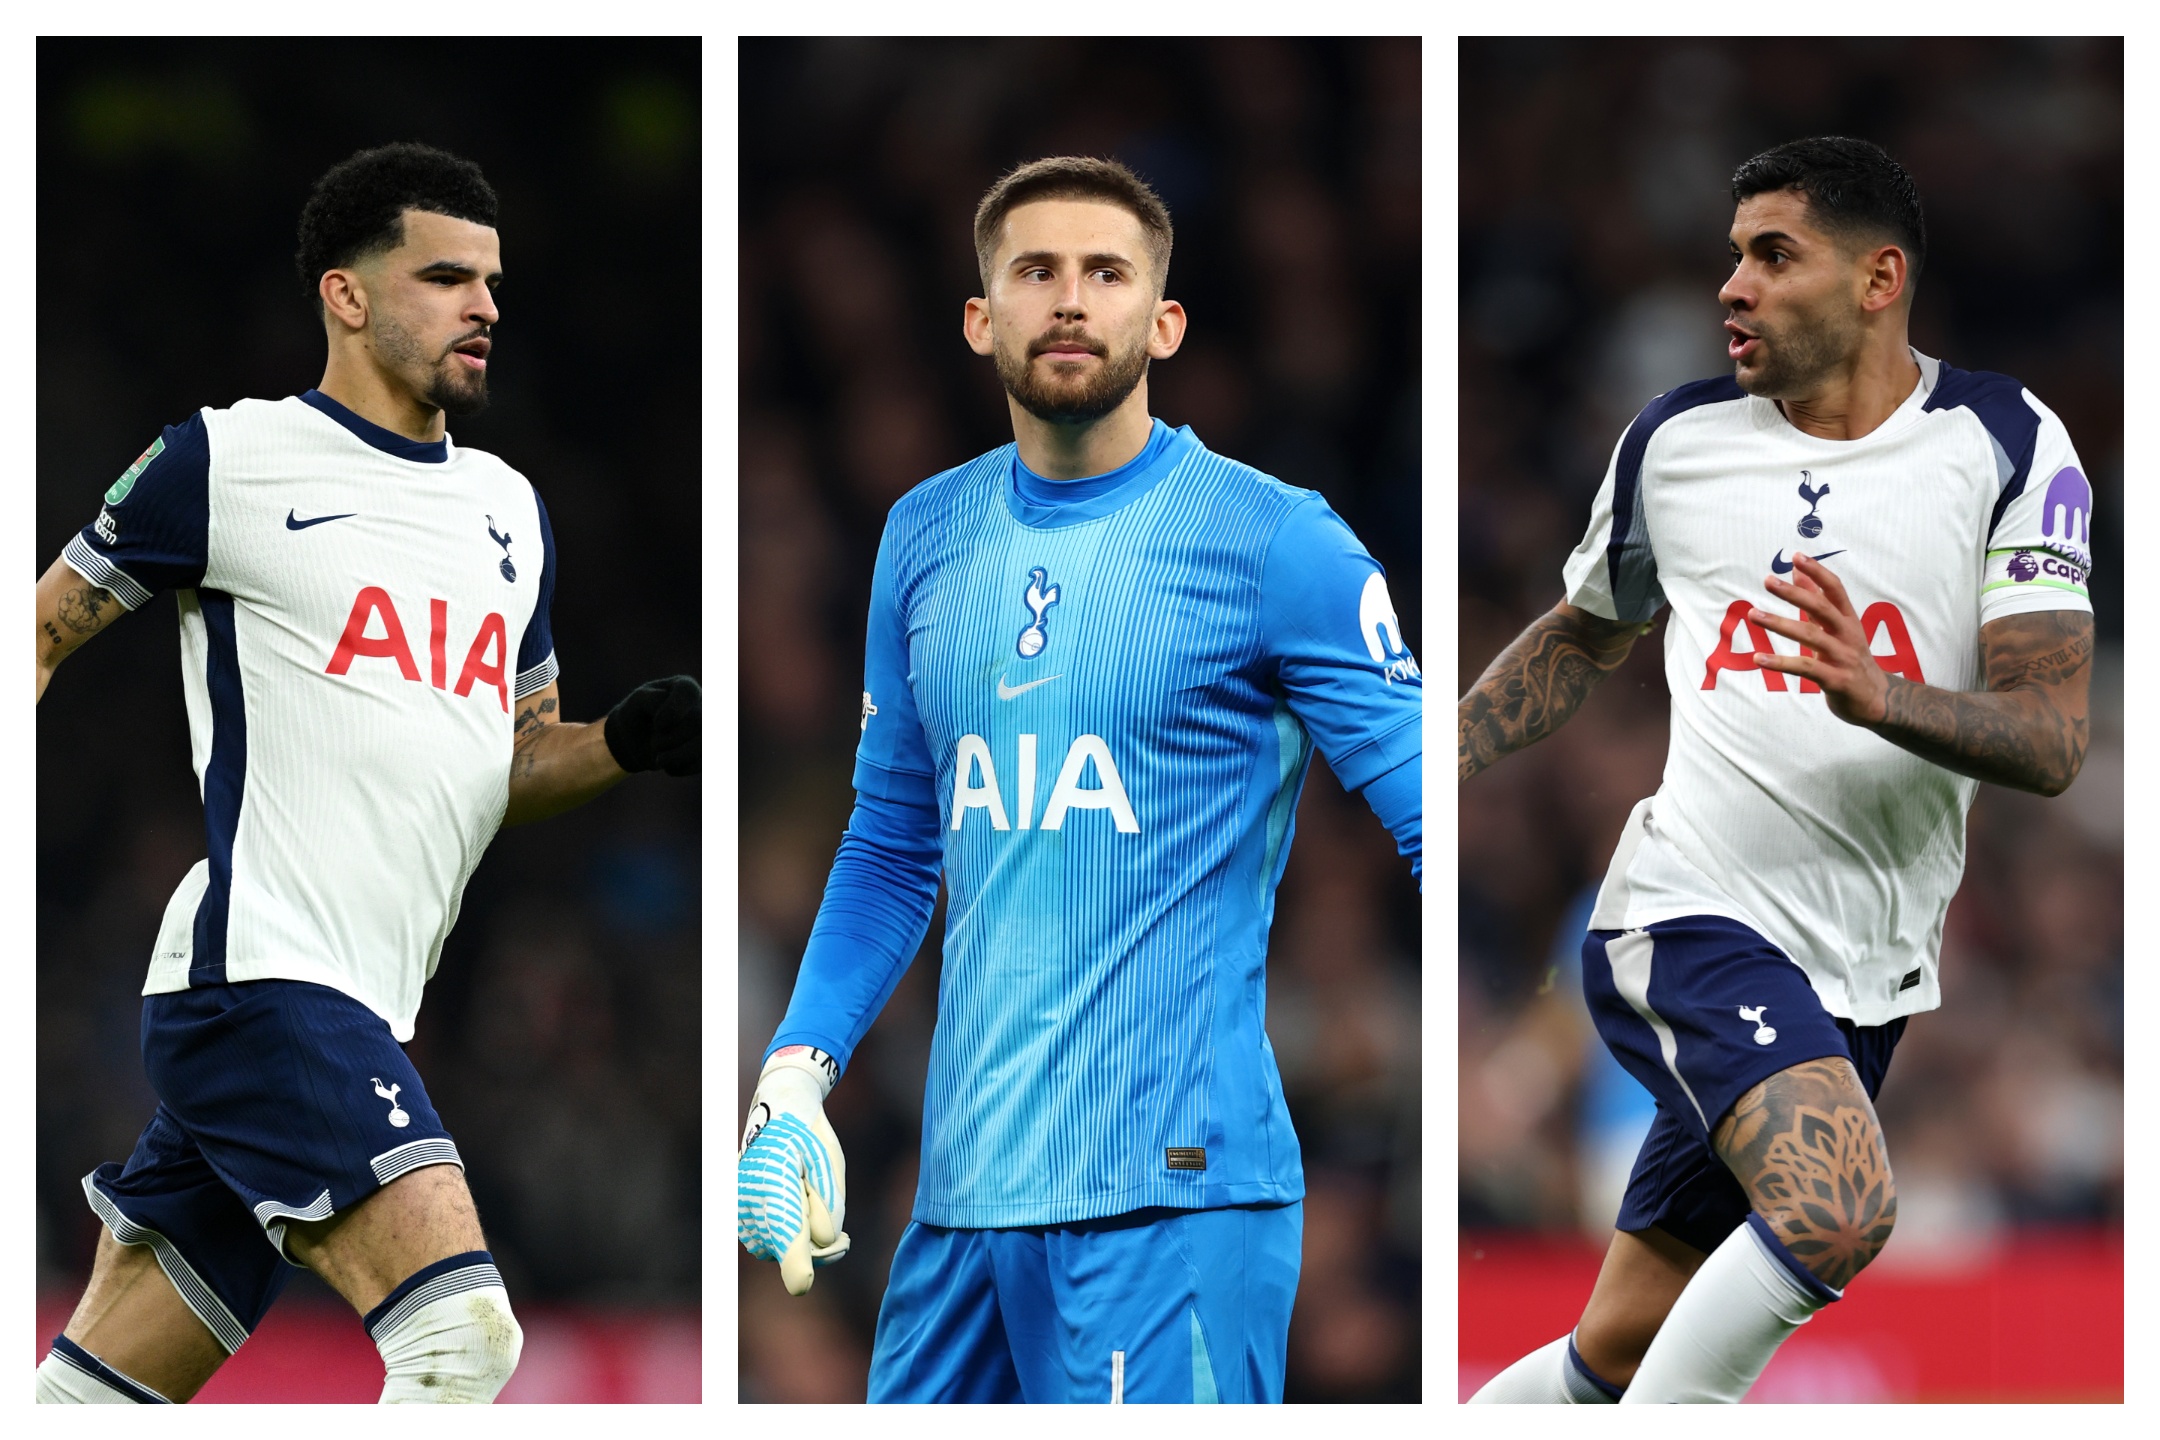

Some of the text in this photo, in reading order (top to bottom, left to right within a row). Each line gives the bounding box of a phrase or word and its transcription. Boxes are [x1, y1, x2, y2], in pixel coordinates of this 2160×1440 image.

[44, 621, 62, 644] LEO
[325, 586, 509, 714] AIA
[951, 734, 1141, 833] AIA
